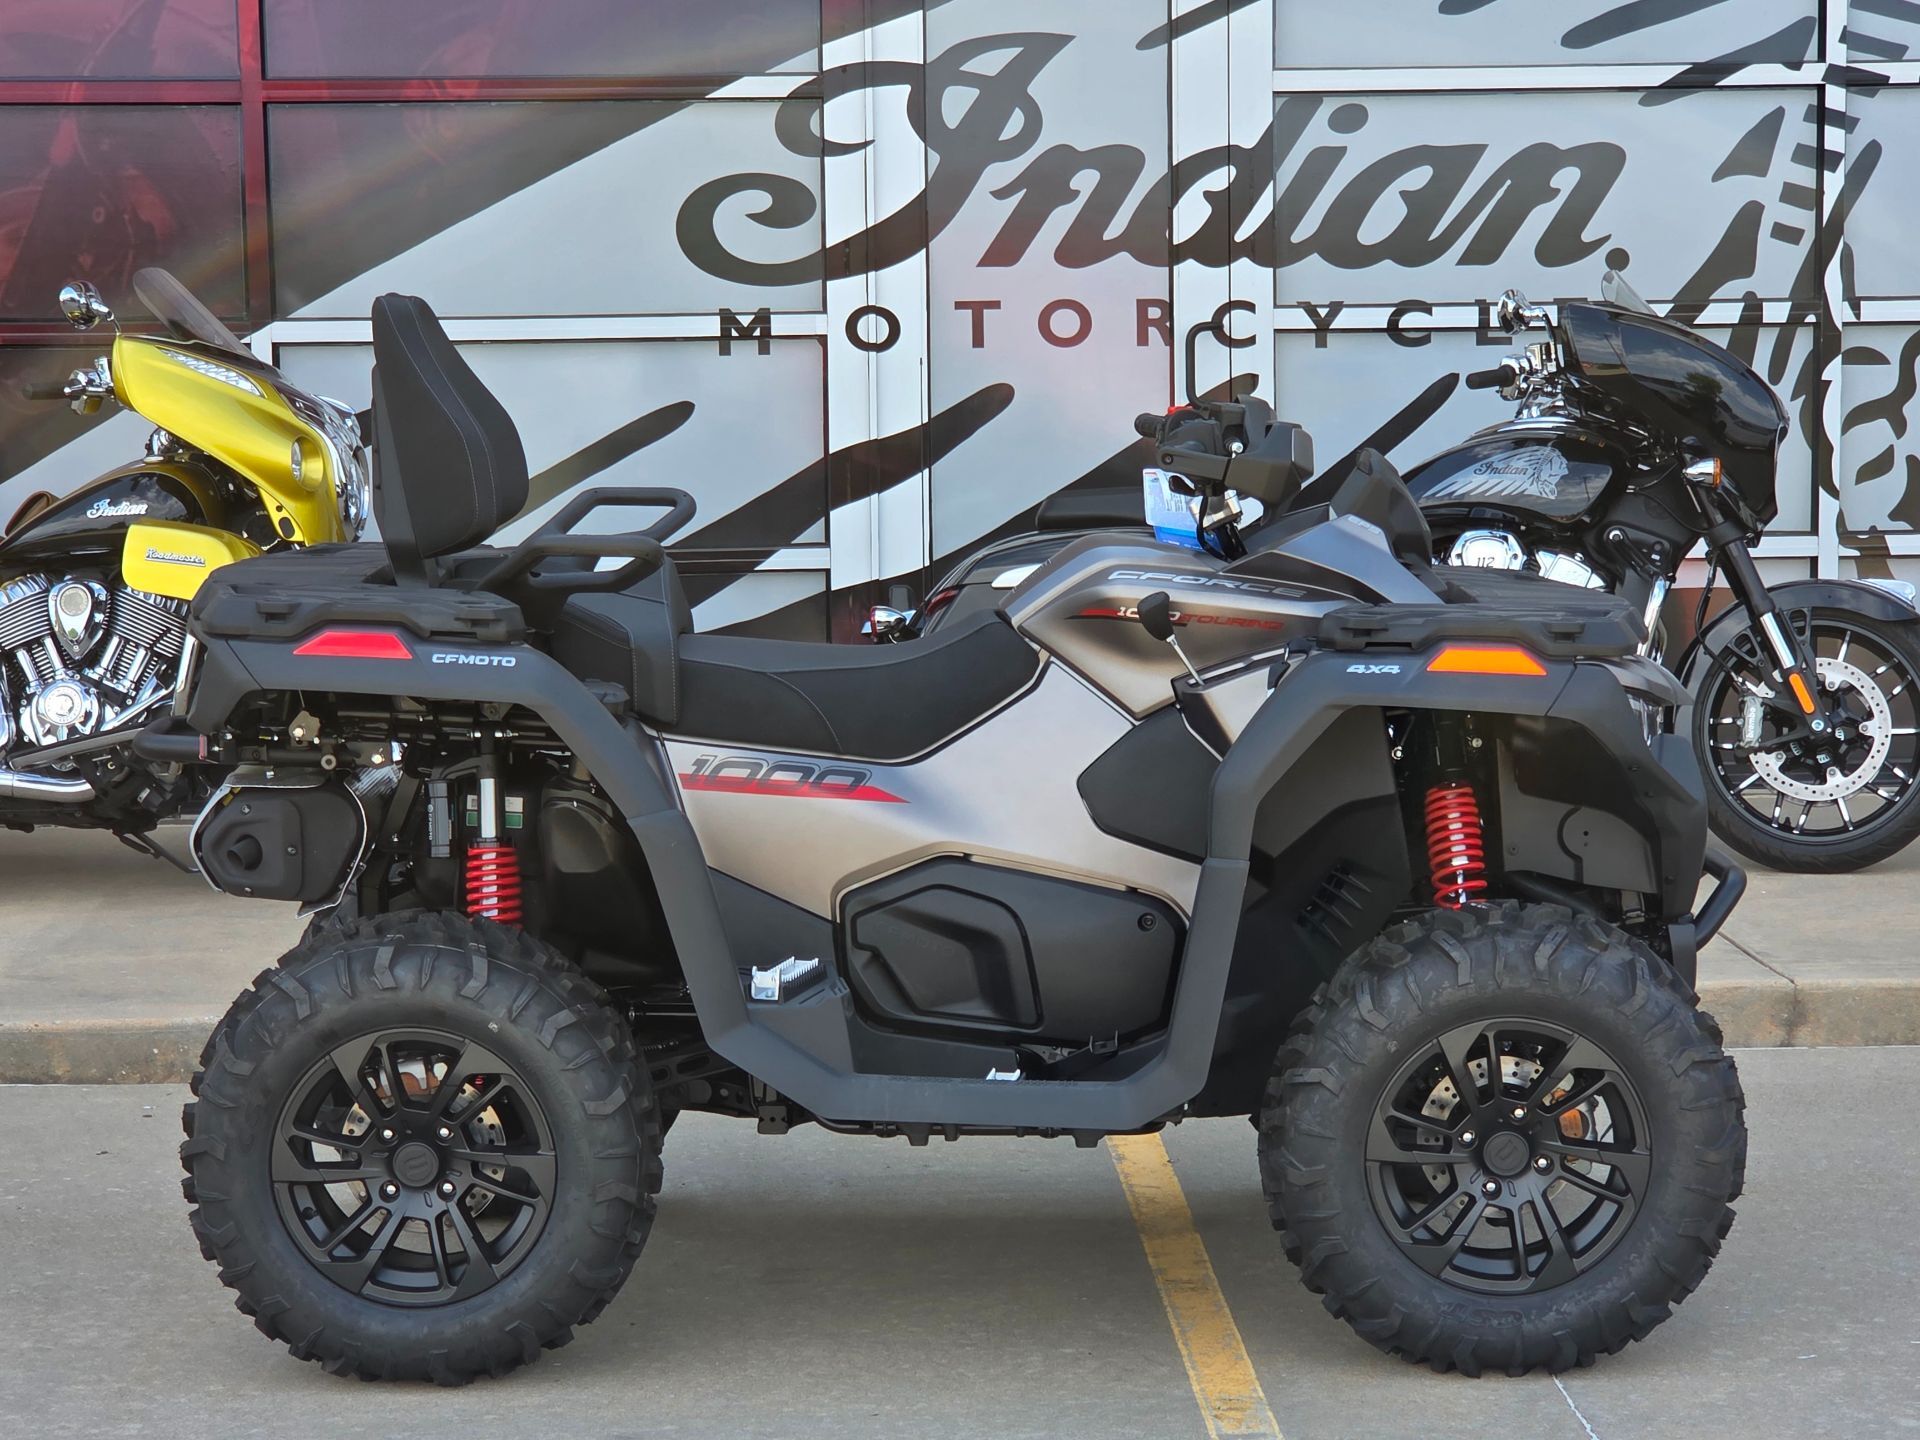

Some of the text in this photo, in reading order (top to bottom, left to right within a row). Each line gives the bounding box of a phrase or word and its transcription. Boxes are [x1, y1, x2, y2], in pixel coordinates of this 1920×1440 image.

[718, 297, 1588, 356] MOTORCYCL
[1473, 461, 1529, 476] Indian
[87, 499, 147, 518] Indian
[145, 548, 206, 564] Roadmaster
[1107, 569, 1308, 597] CFORCE
[1181, 613, 1285, 630] TOURING
[431, 653, 516, 667] CFMOTO
[690, 754, 873, 793] 1000
